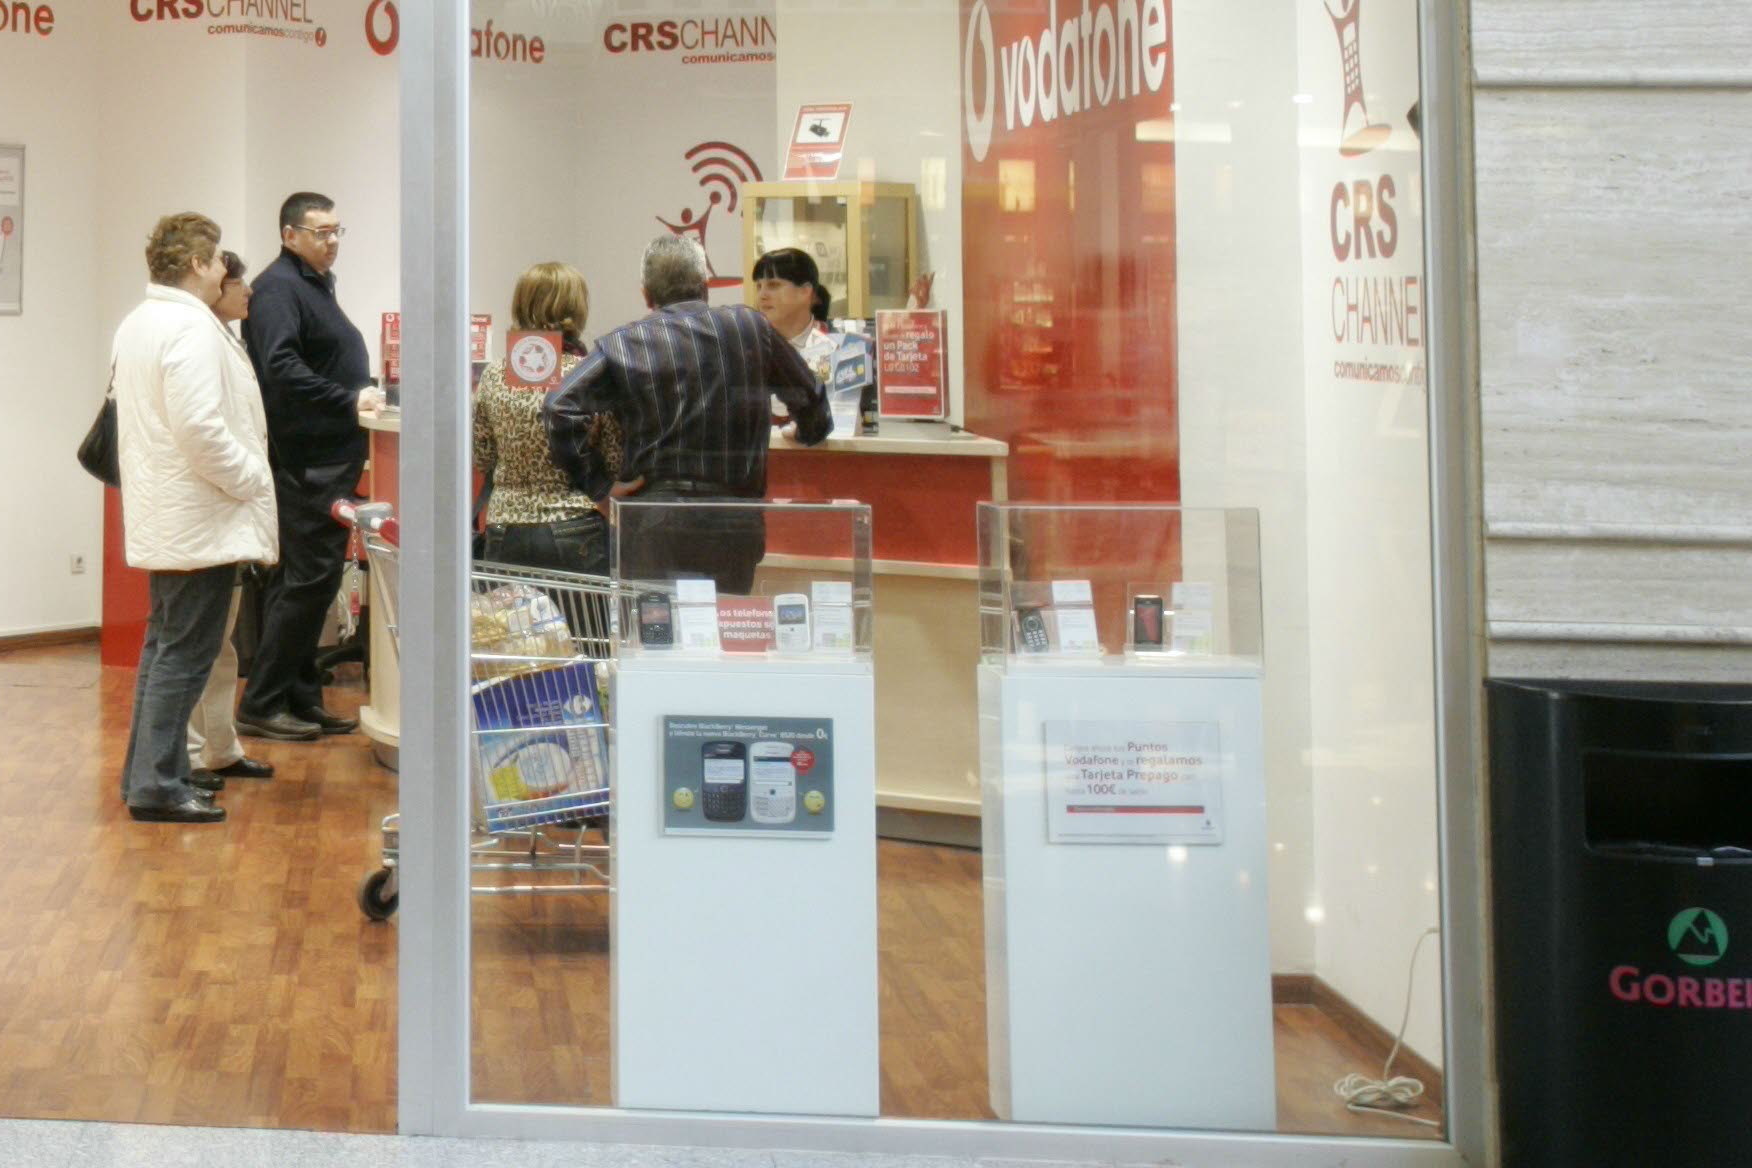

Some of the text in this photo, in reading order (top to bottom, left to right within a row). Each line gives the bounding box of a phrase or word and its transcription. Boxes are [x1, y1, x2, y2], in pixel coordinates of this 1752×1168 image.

[681, 51, 777, 64] comunicamos
[1330, 174, 1398, 262] CRS
[1127, 741, 1168, 752] Puntos
[1065, 755, 1119, 766] Vodafone
[1135, 755, 1203, 768] regalamos
[1081, 768, 1124, 781] Tarjeta
[1126, 769, 1178, 783] Prepago
